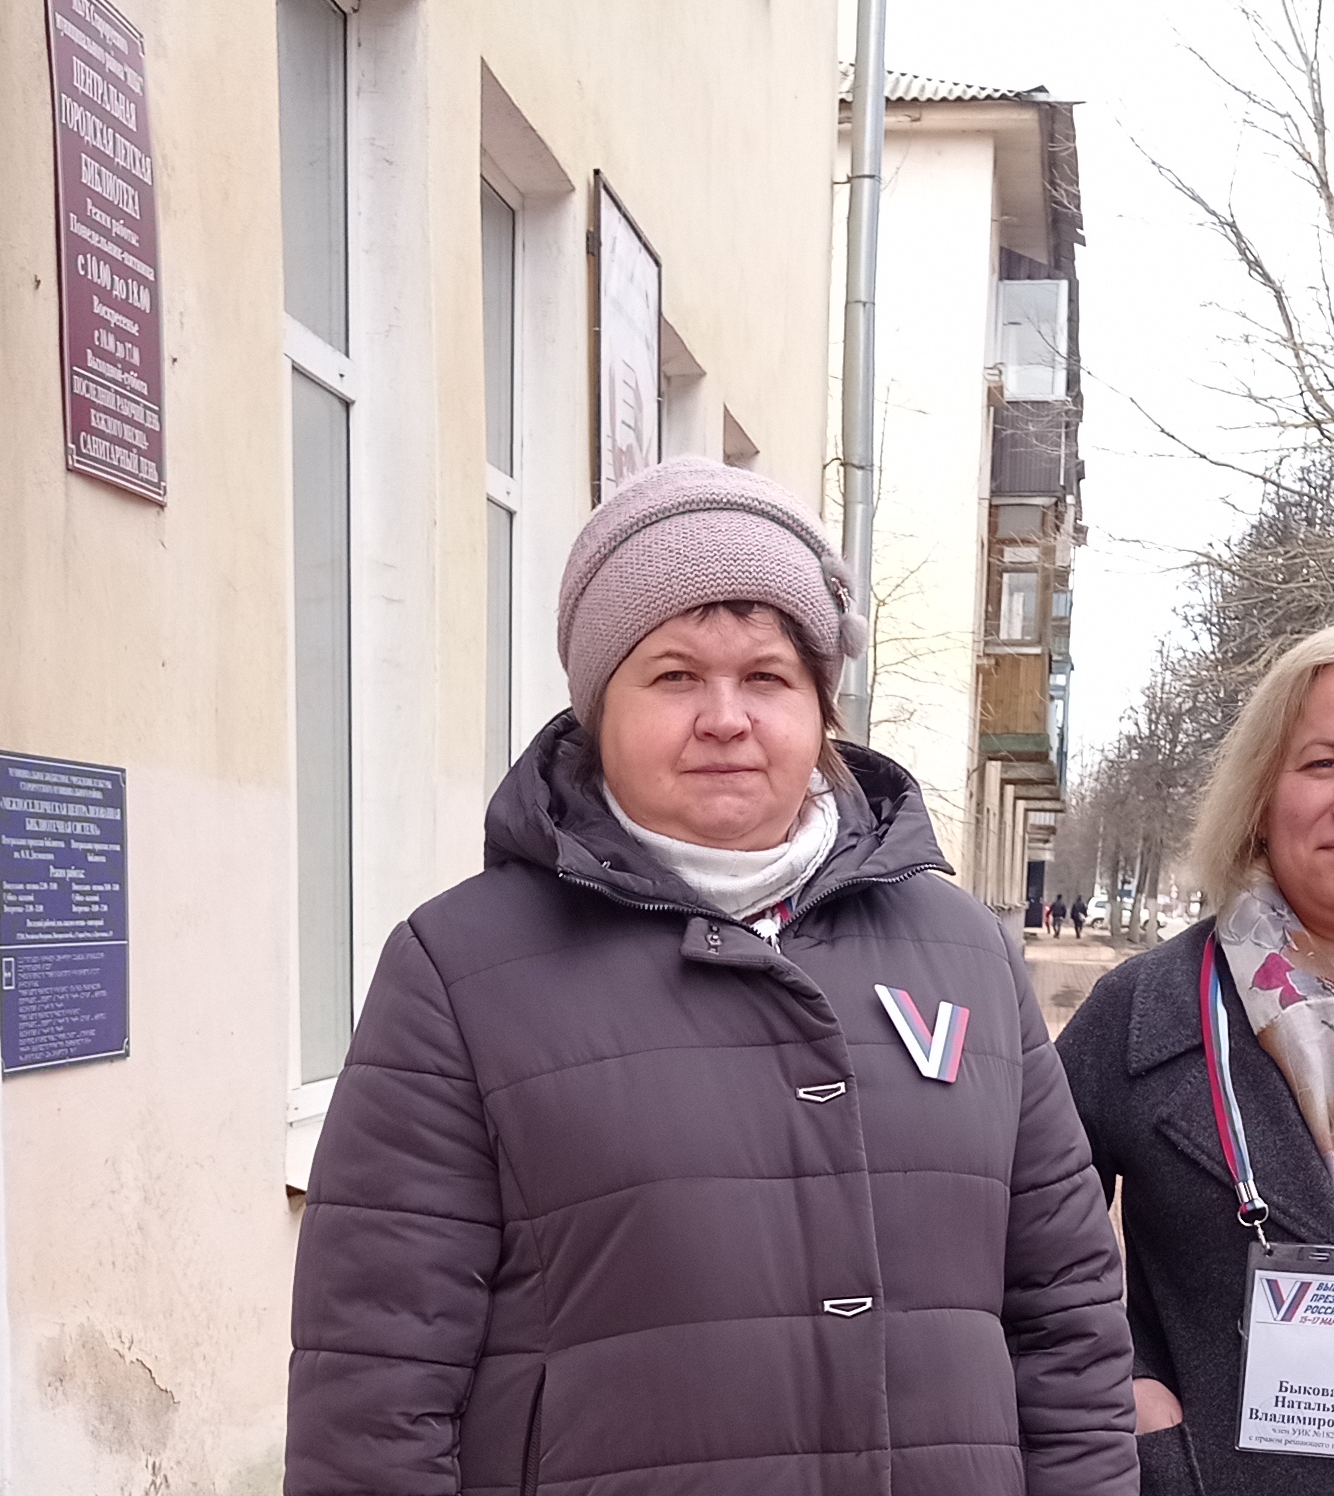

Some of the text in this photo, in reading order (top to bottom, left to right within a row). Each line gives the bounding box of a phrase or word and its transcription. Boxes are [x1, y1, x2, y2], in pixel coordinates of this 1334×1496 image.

[72, 55, 137, 132] ЦЕНТРАЛЬНАЯ
[61, 92, 153, 186] ГОРОДСКАЯ ДЕТСКАЯ
[81, 152, 140, 220] БИБЛИОТЕКА
[87, 253, 111, 291] 10.00
[112, 274, 127, 300] до
[128, 278, 151, 314] 18.00
[80, 432, 159, 483] САНИТАРНЫЙ ДЕНЬ
